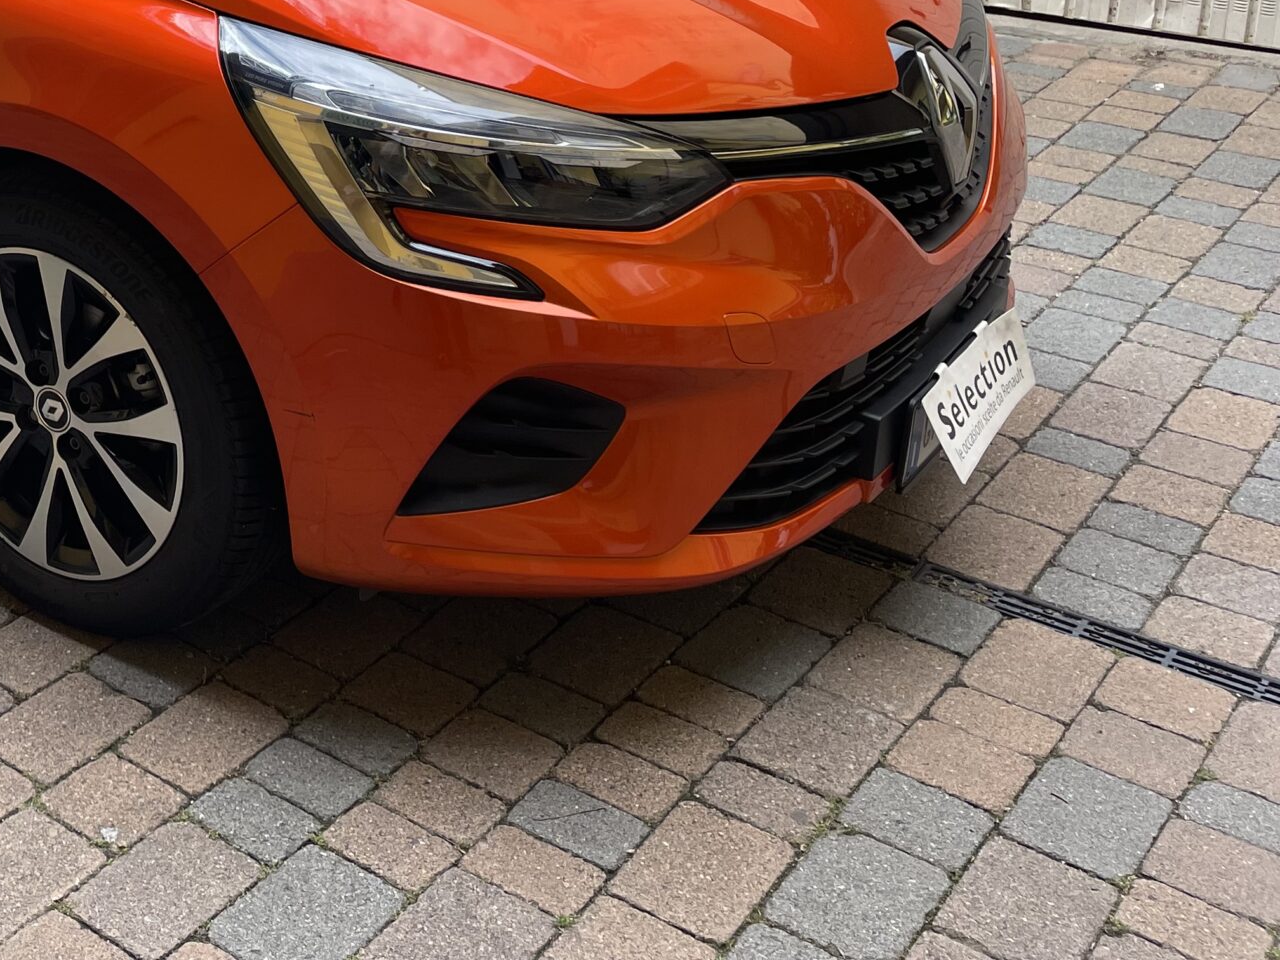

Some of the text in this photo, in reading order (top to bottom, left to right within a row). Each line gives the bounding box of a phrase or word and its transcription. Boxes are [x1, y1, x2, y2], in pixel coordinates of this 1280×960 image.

[15, 203, 154, 302] BRIDGESTONE
[937, 340, 1018, 440] Selection
[962, 416, 985, 454] occasioni
[982, 402, 998, 425] scelte
[995, 391, 1005, 406] da
[1001, 368, 1024, 397] Renault
